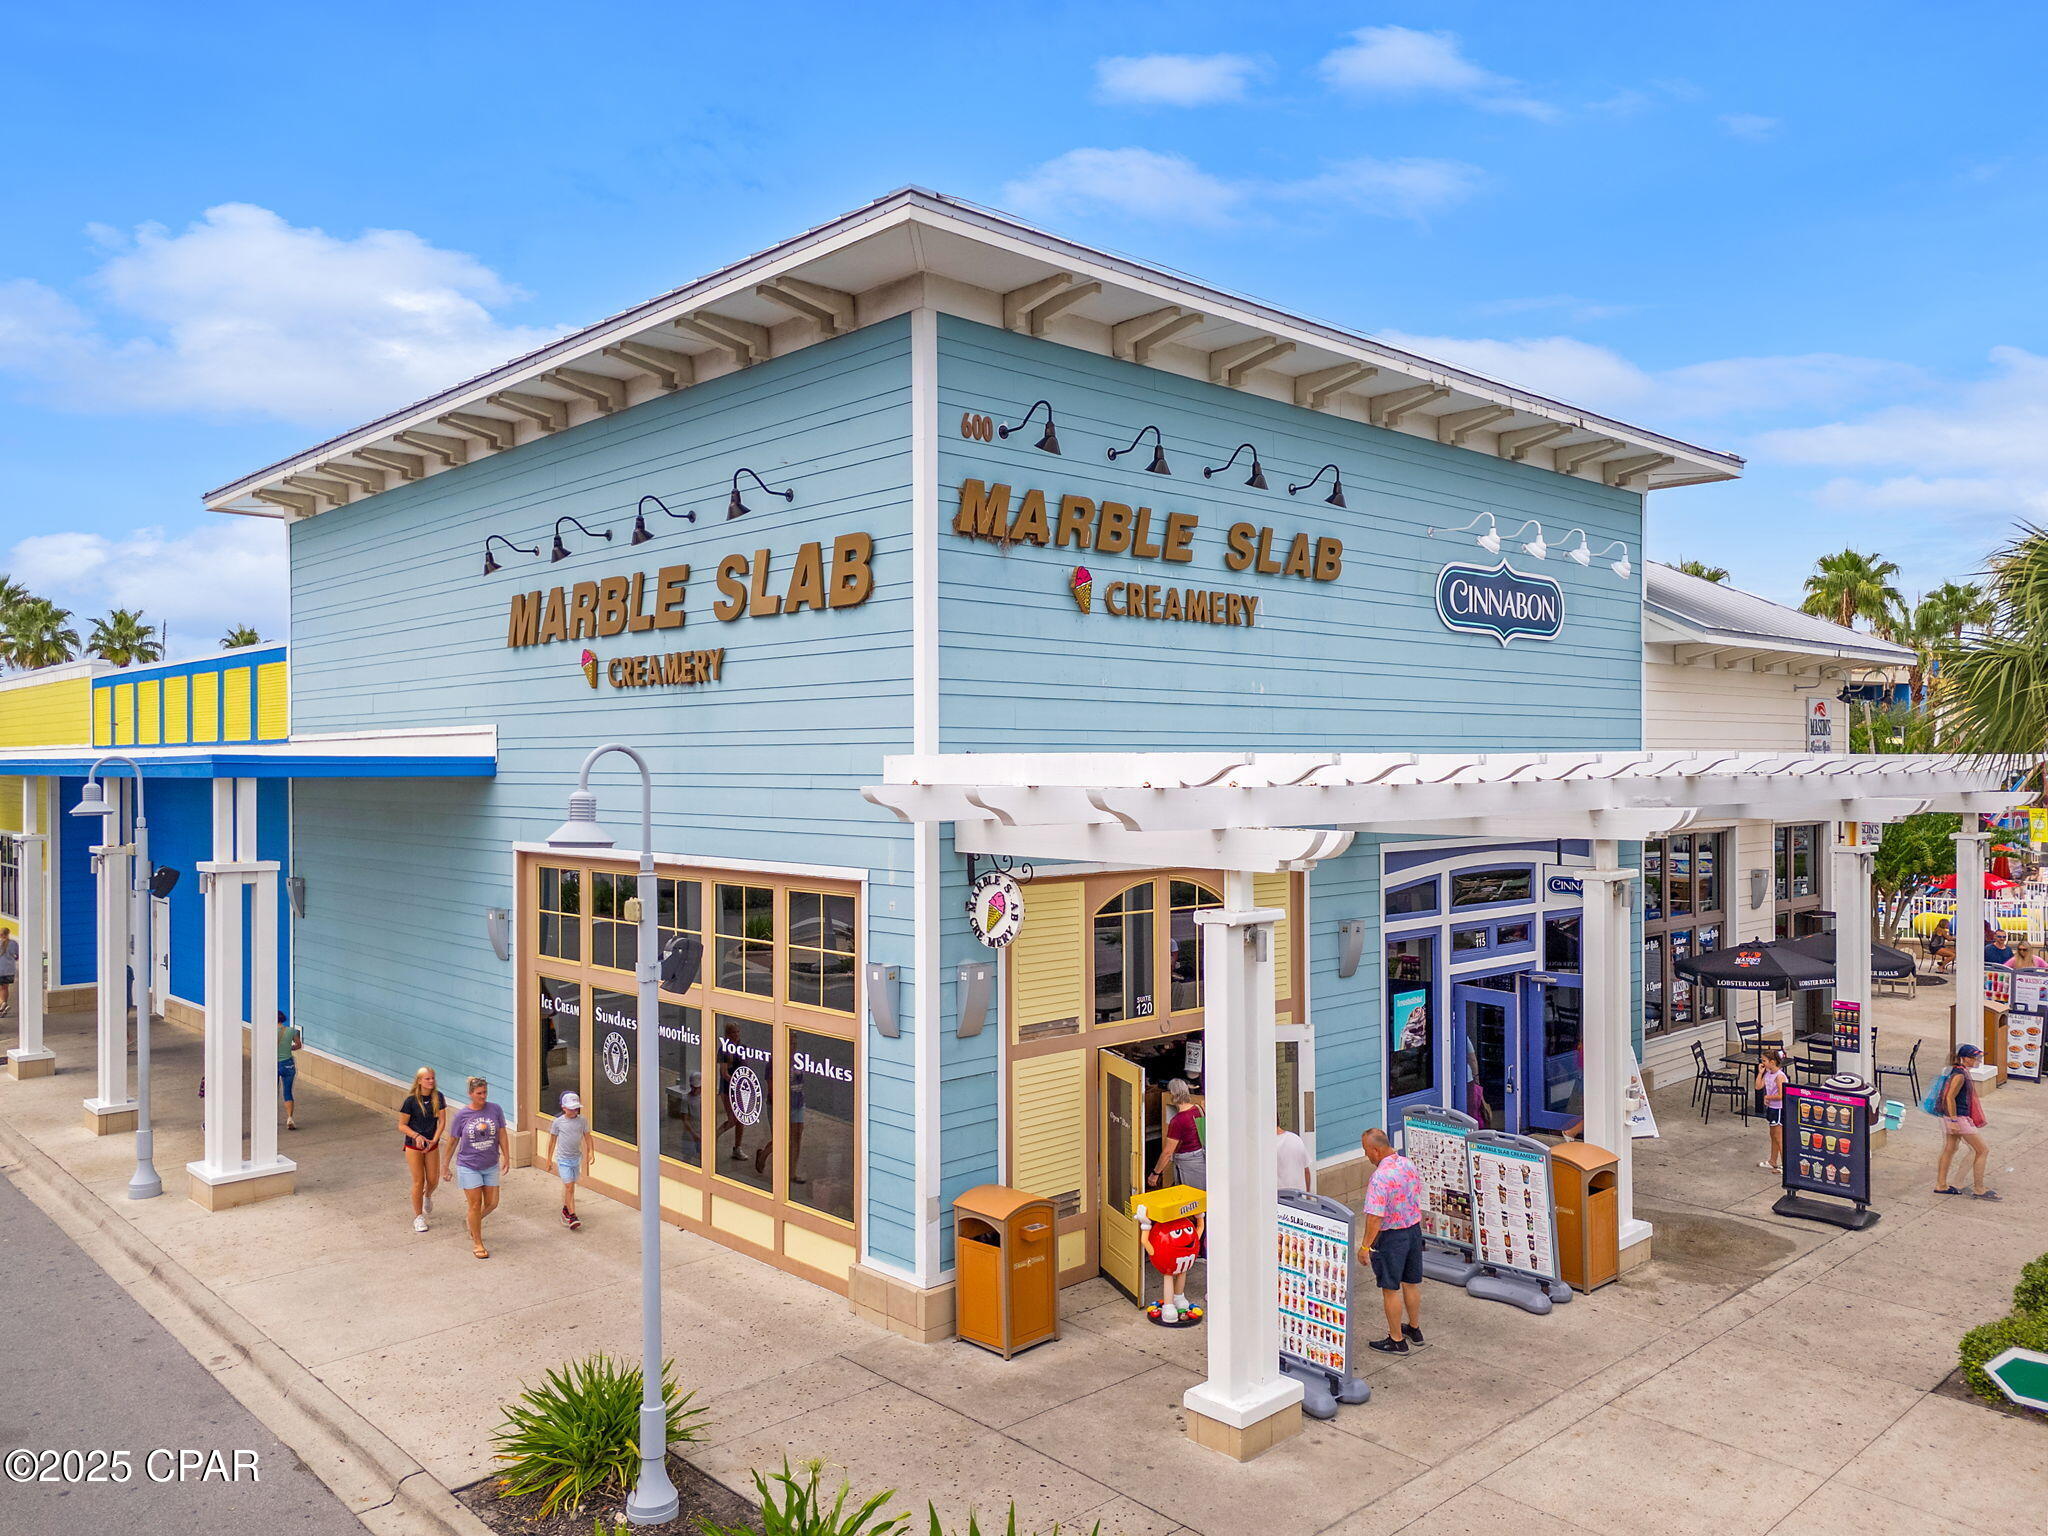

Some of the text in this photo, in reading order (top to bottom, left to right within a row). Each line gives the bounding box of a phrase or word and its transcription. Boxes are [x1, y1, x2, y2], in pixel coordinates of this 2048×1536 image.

[961, 412, 993, 443] 600
[956, 478, 1345, 582] MARBLE SLAB
[507, 531, 874, 648] MARBLE SLAB
[1449, 577, 1558, 624] CINNABON
[1104, 580, 1260, 627] CREAMERY
[608, 647, 726, 689] CREAMERY
[965, 875, 1001, 913] MARBLE
[969, 917, 1015, 948] CREMERY
[1475, 938, 1486, 948] 115
[1717, 979, 1770, 988] LOBSTER ROLLS
[1799, 978, 1836, 987] LOBSTER ROLLS
[1136, 995, 1152, 1003] SUITE
[1136, 1003, 1153, 1015] 120
[658, 1023, 700, 1045] moothies
[1477, 1144, 1497, 1153] MARBLE
[1510, 1150, 1538, 1160] CREAMERY
[1290, 1215, 1304, 1226] SLAB
[1304, 1221, 1324, 1231] CREAMERY
